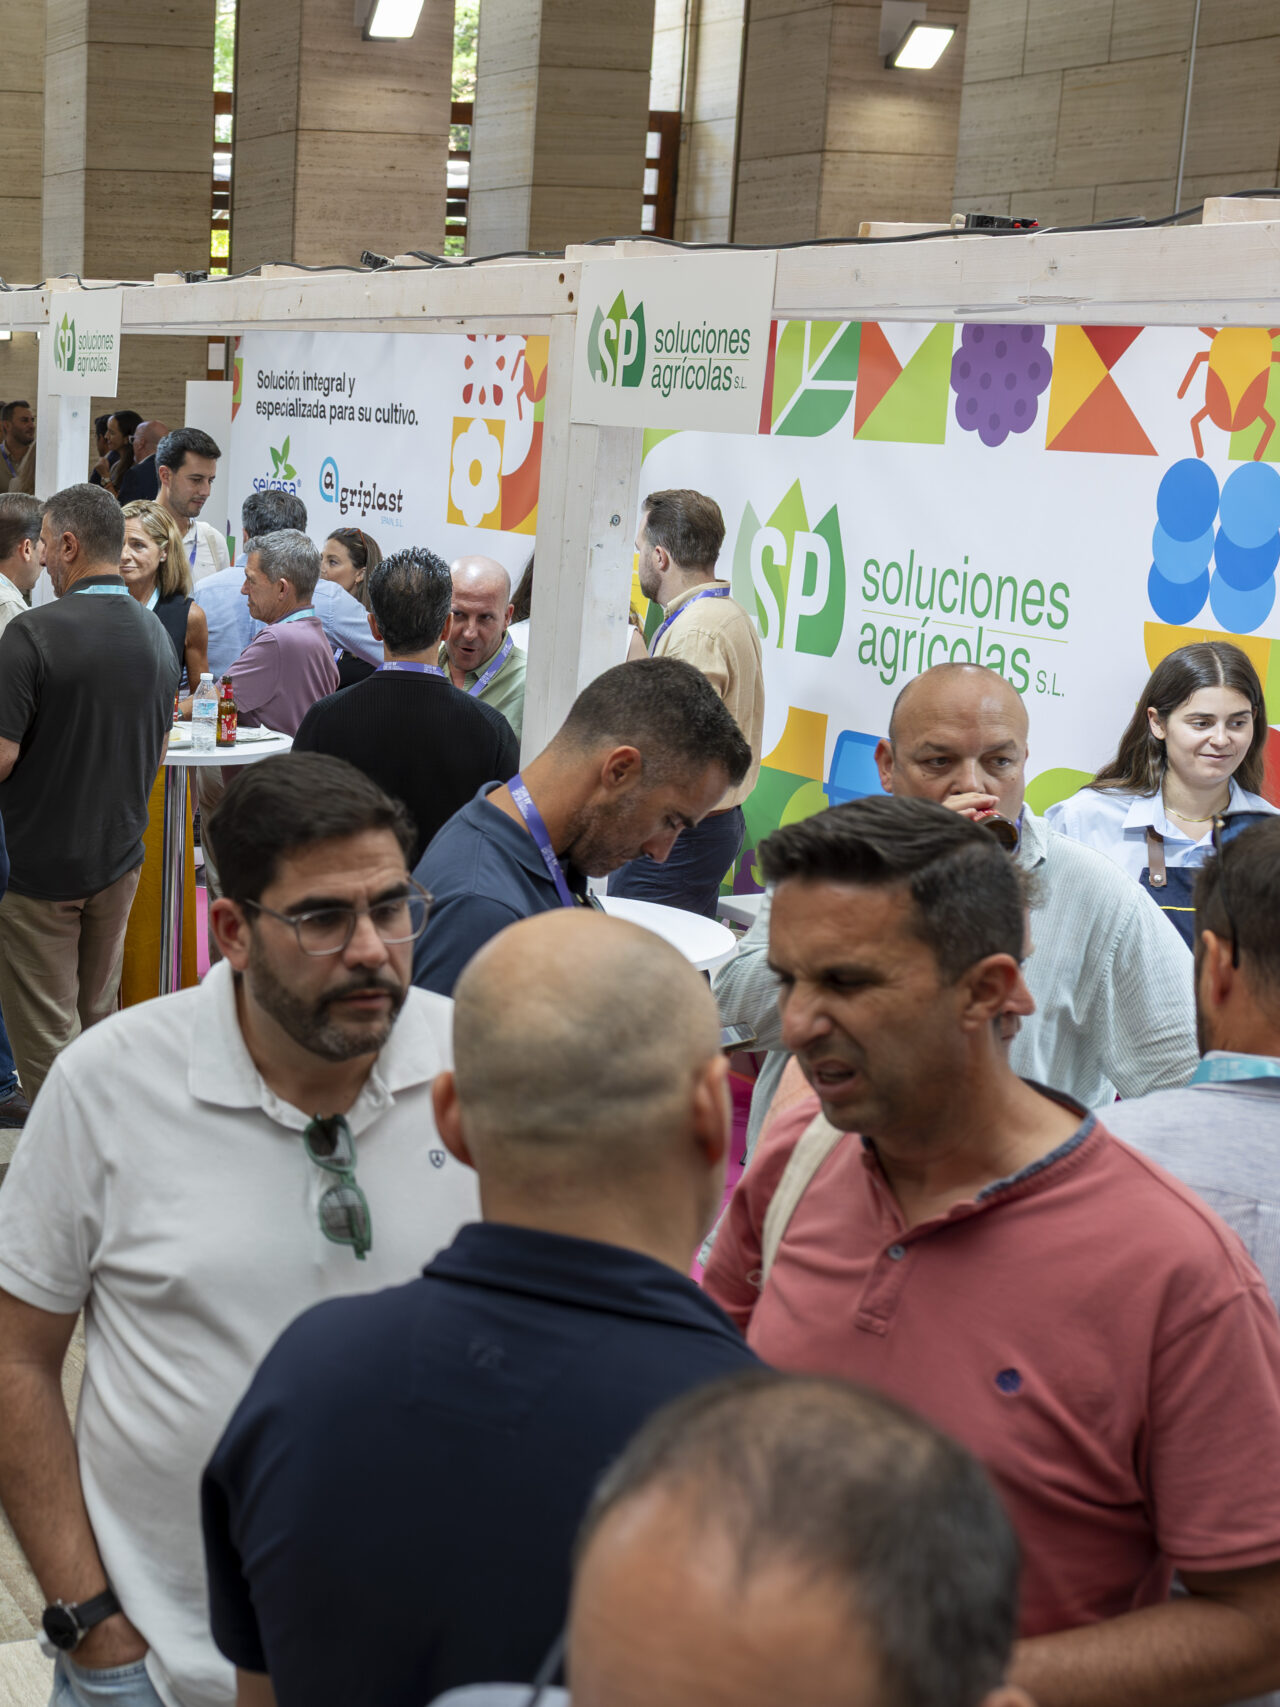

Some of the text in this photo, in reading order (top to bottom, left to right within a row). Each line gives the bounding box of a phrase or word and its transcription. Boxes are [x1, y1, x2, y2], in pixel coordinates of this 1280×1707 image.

[78, 330, 114, 350] soluciones
[596, 318, 640, 387] SP
[654, 321, 751, 354] soluciones
[77, 352, 107, 377] agrícolas
[651, 357, 733, 397] agrícolas
[257, 369, 356, 398] Solución integral y
[256, 397, 419, 426] especializada para su cultivo.
[750, 525, 831, 652] SP
[861, 549, 1071, 630] soluciones
[1035, 670, 1065, 698] S.L.
